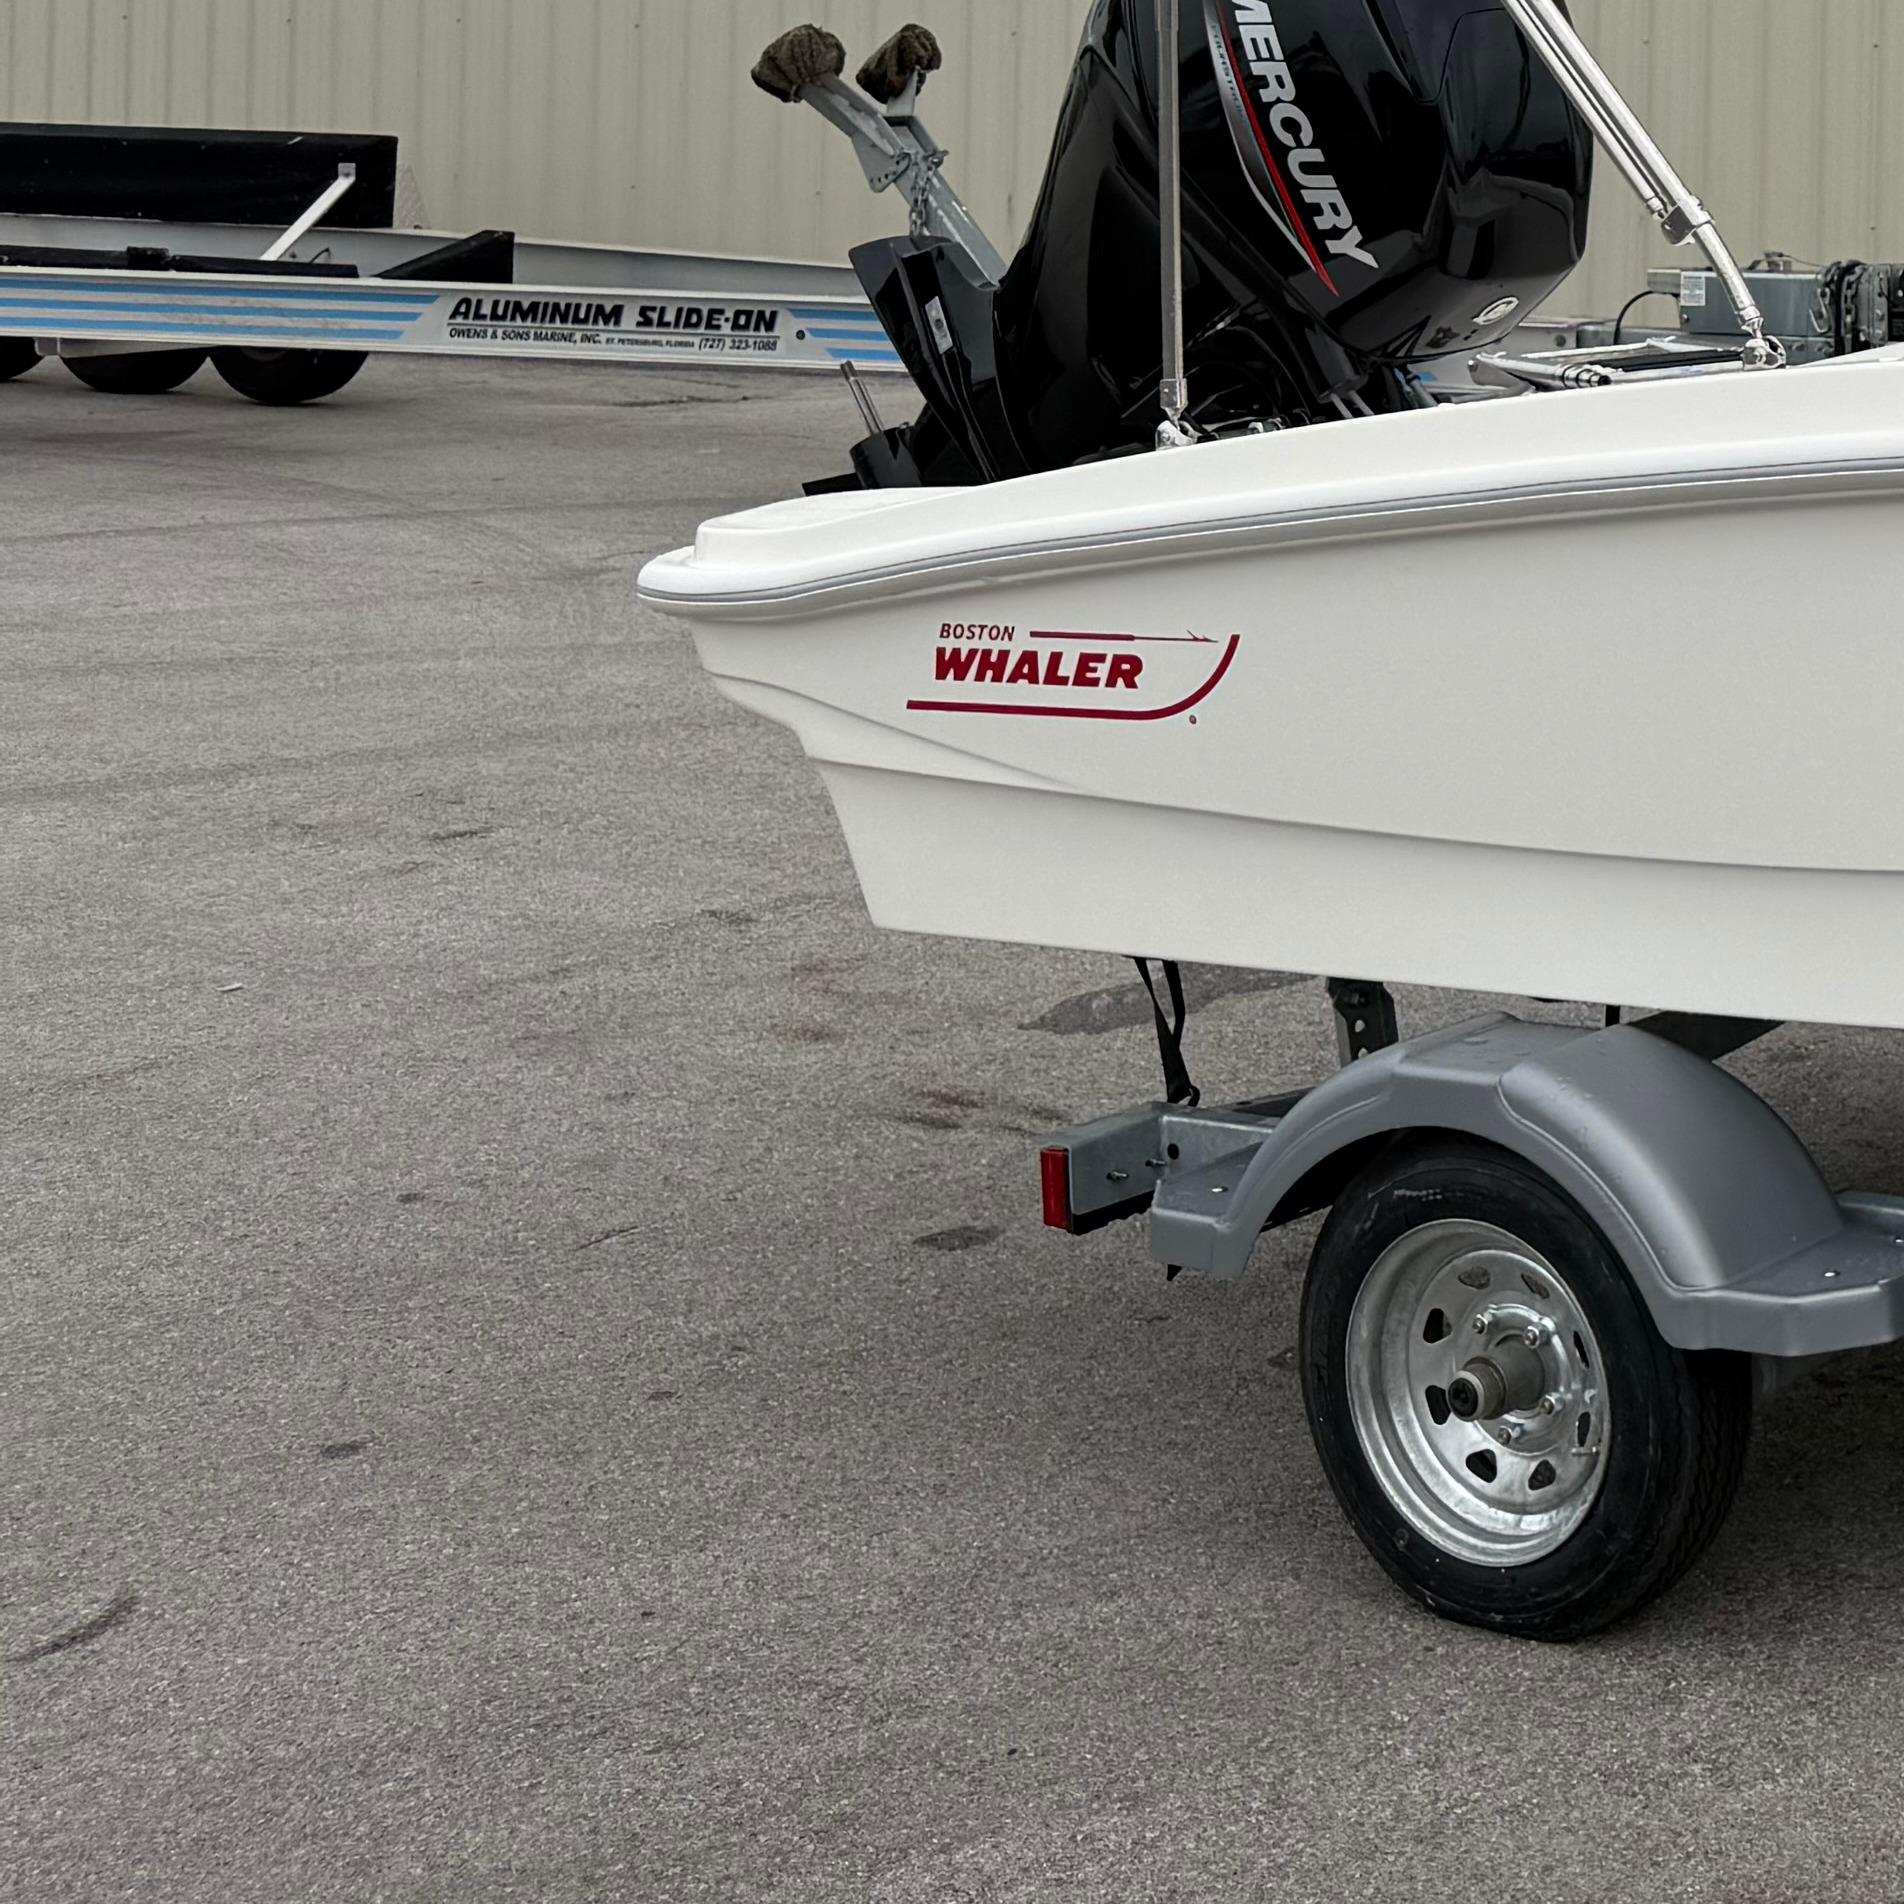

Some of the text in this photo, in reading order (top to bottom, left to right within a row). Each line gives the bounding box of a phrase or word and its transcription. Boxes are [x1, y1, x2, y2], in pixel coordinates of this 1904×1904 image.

[449, 297, 624, 327] ALUMINUM
[449, 328, 488, 339] OWENS
[490, 329, 498, 339] &
[501, 330, 531, 341] SONS
[580, 333, 602, 344] INC.
[698, 336, 725, 351] (727)
[939, 623, 1015, 642] BOSTON
[935, 647, 1143, 689] WHALER
